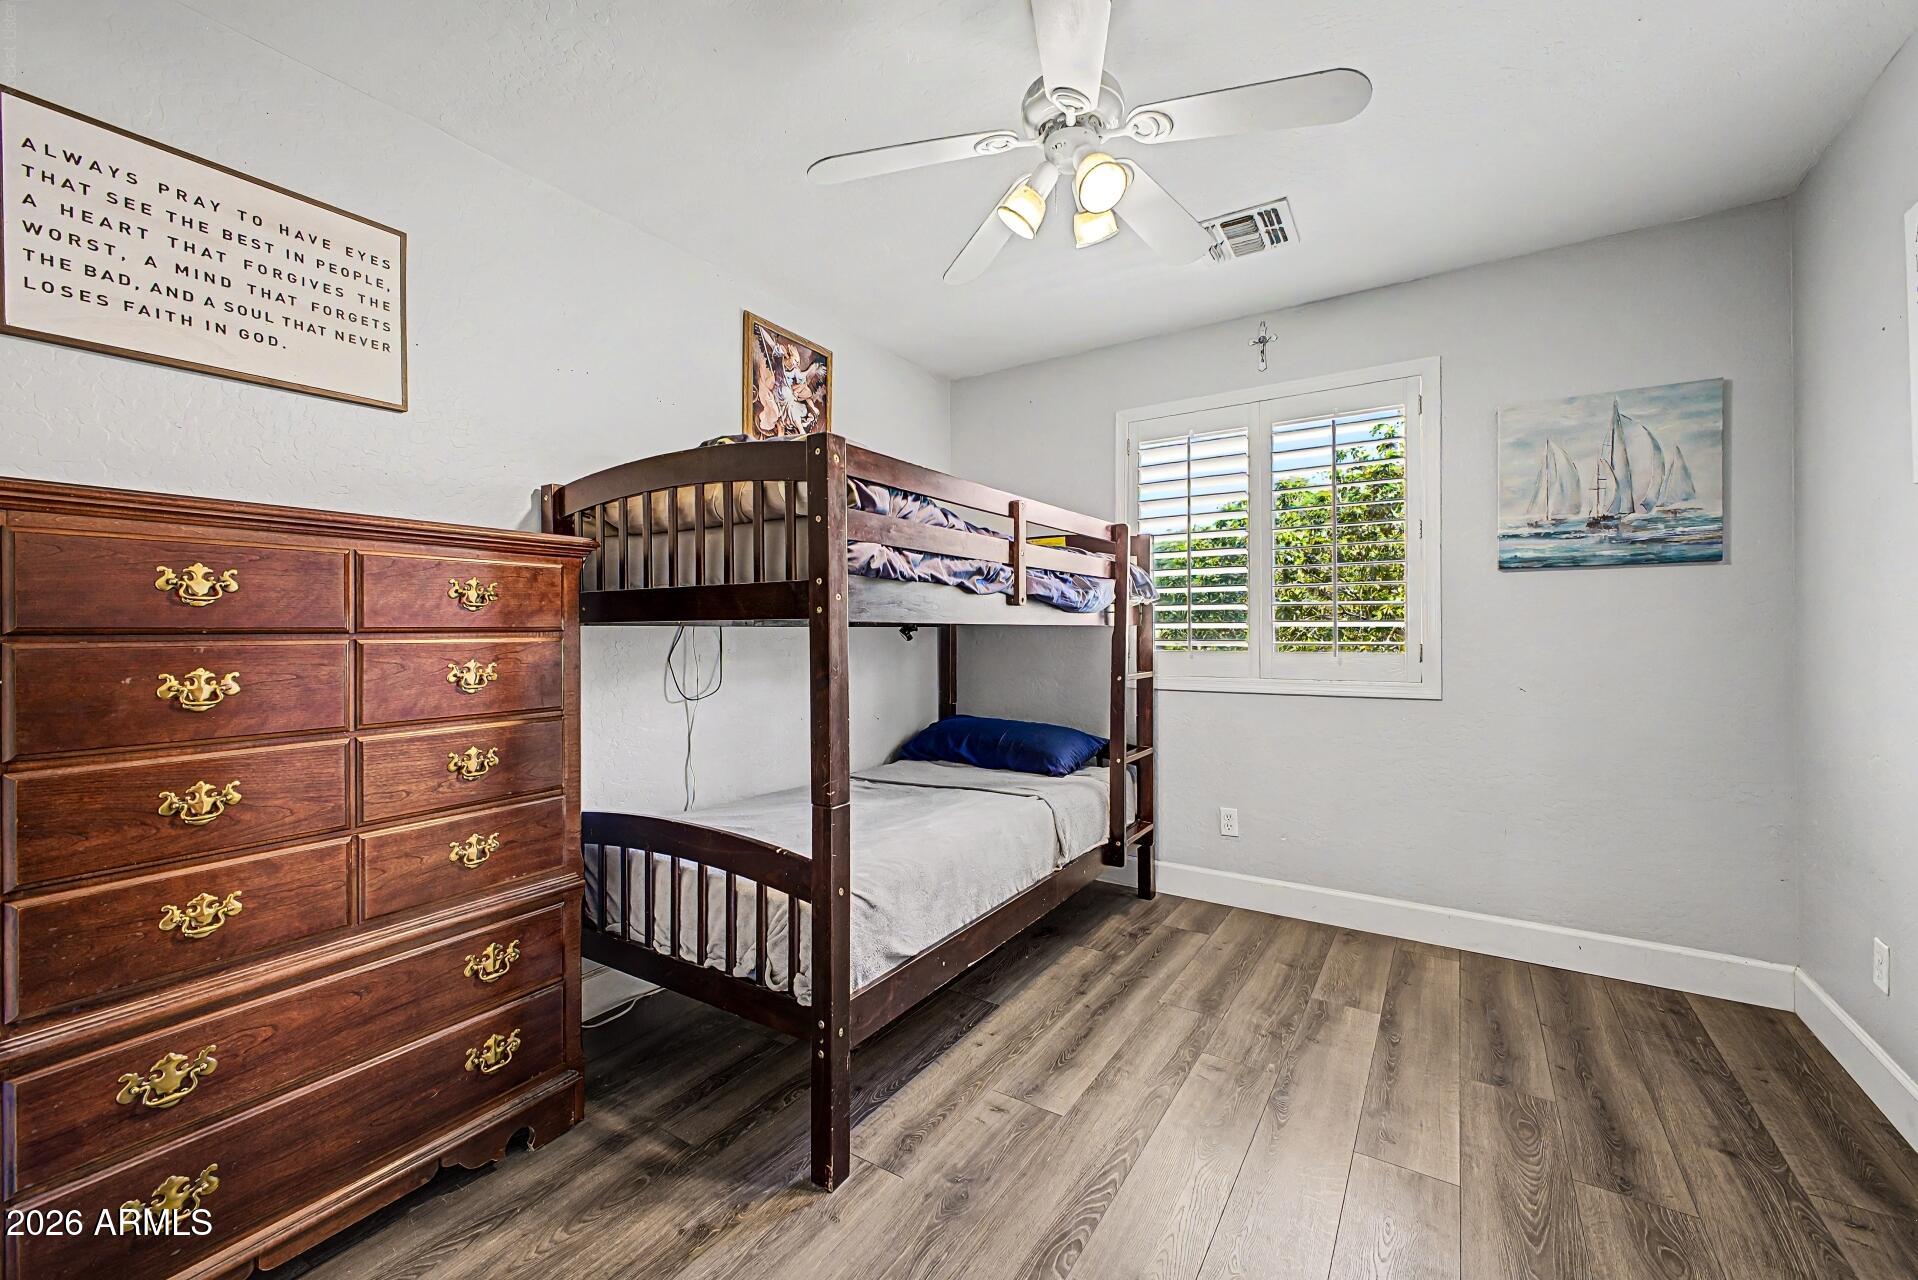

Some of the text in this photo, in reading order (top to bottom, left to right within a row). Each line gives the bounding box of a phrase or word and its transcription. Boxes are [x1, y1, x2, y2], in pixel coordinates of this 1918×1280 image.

[21, 138, 390, 269] ALWAYS PRAY TO HAVE EYES
[22, 164, 389, 292] THAT SEE THE BEST IN PEOPLE,
[22, 194, 390, 311] A HEART THAT FORGIVES THE
[22, 220, 390, 331] WORST, A MIND THAT FORGETS
[23, 248, 390, 352] THE BAD, AND A SOUL THAT NEVER
[24, 277, 285, 349] LOSES FAITH IN GOD.
